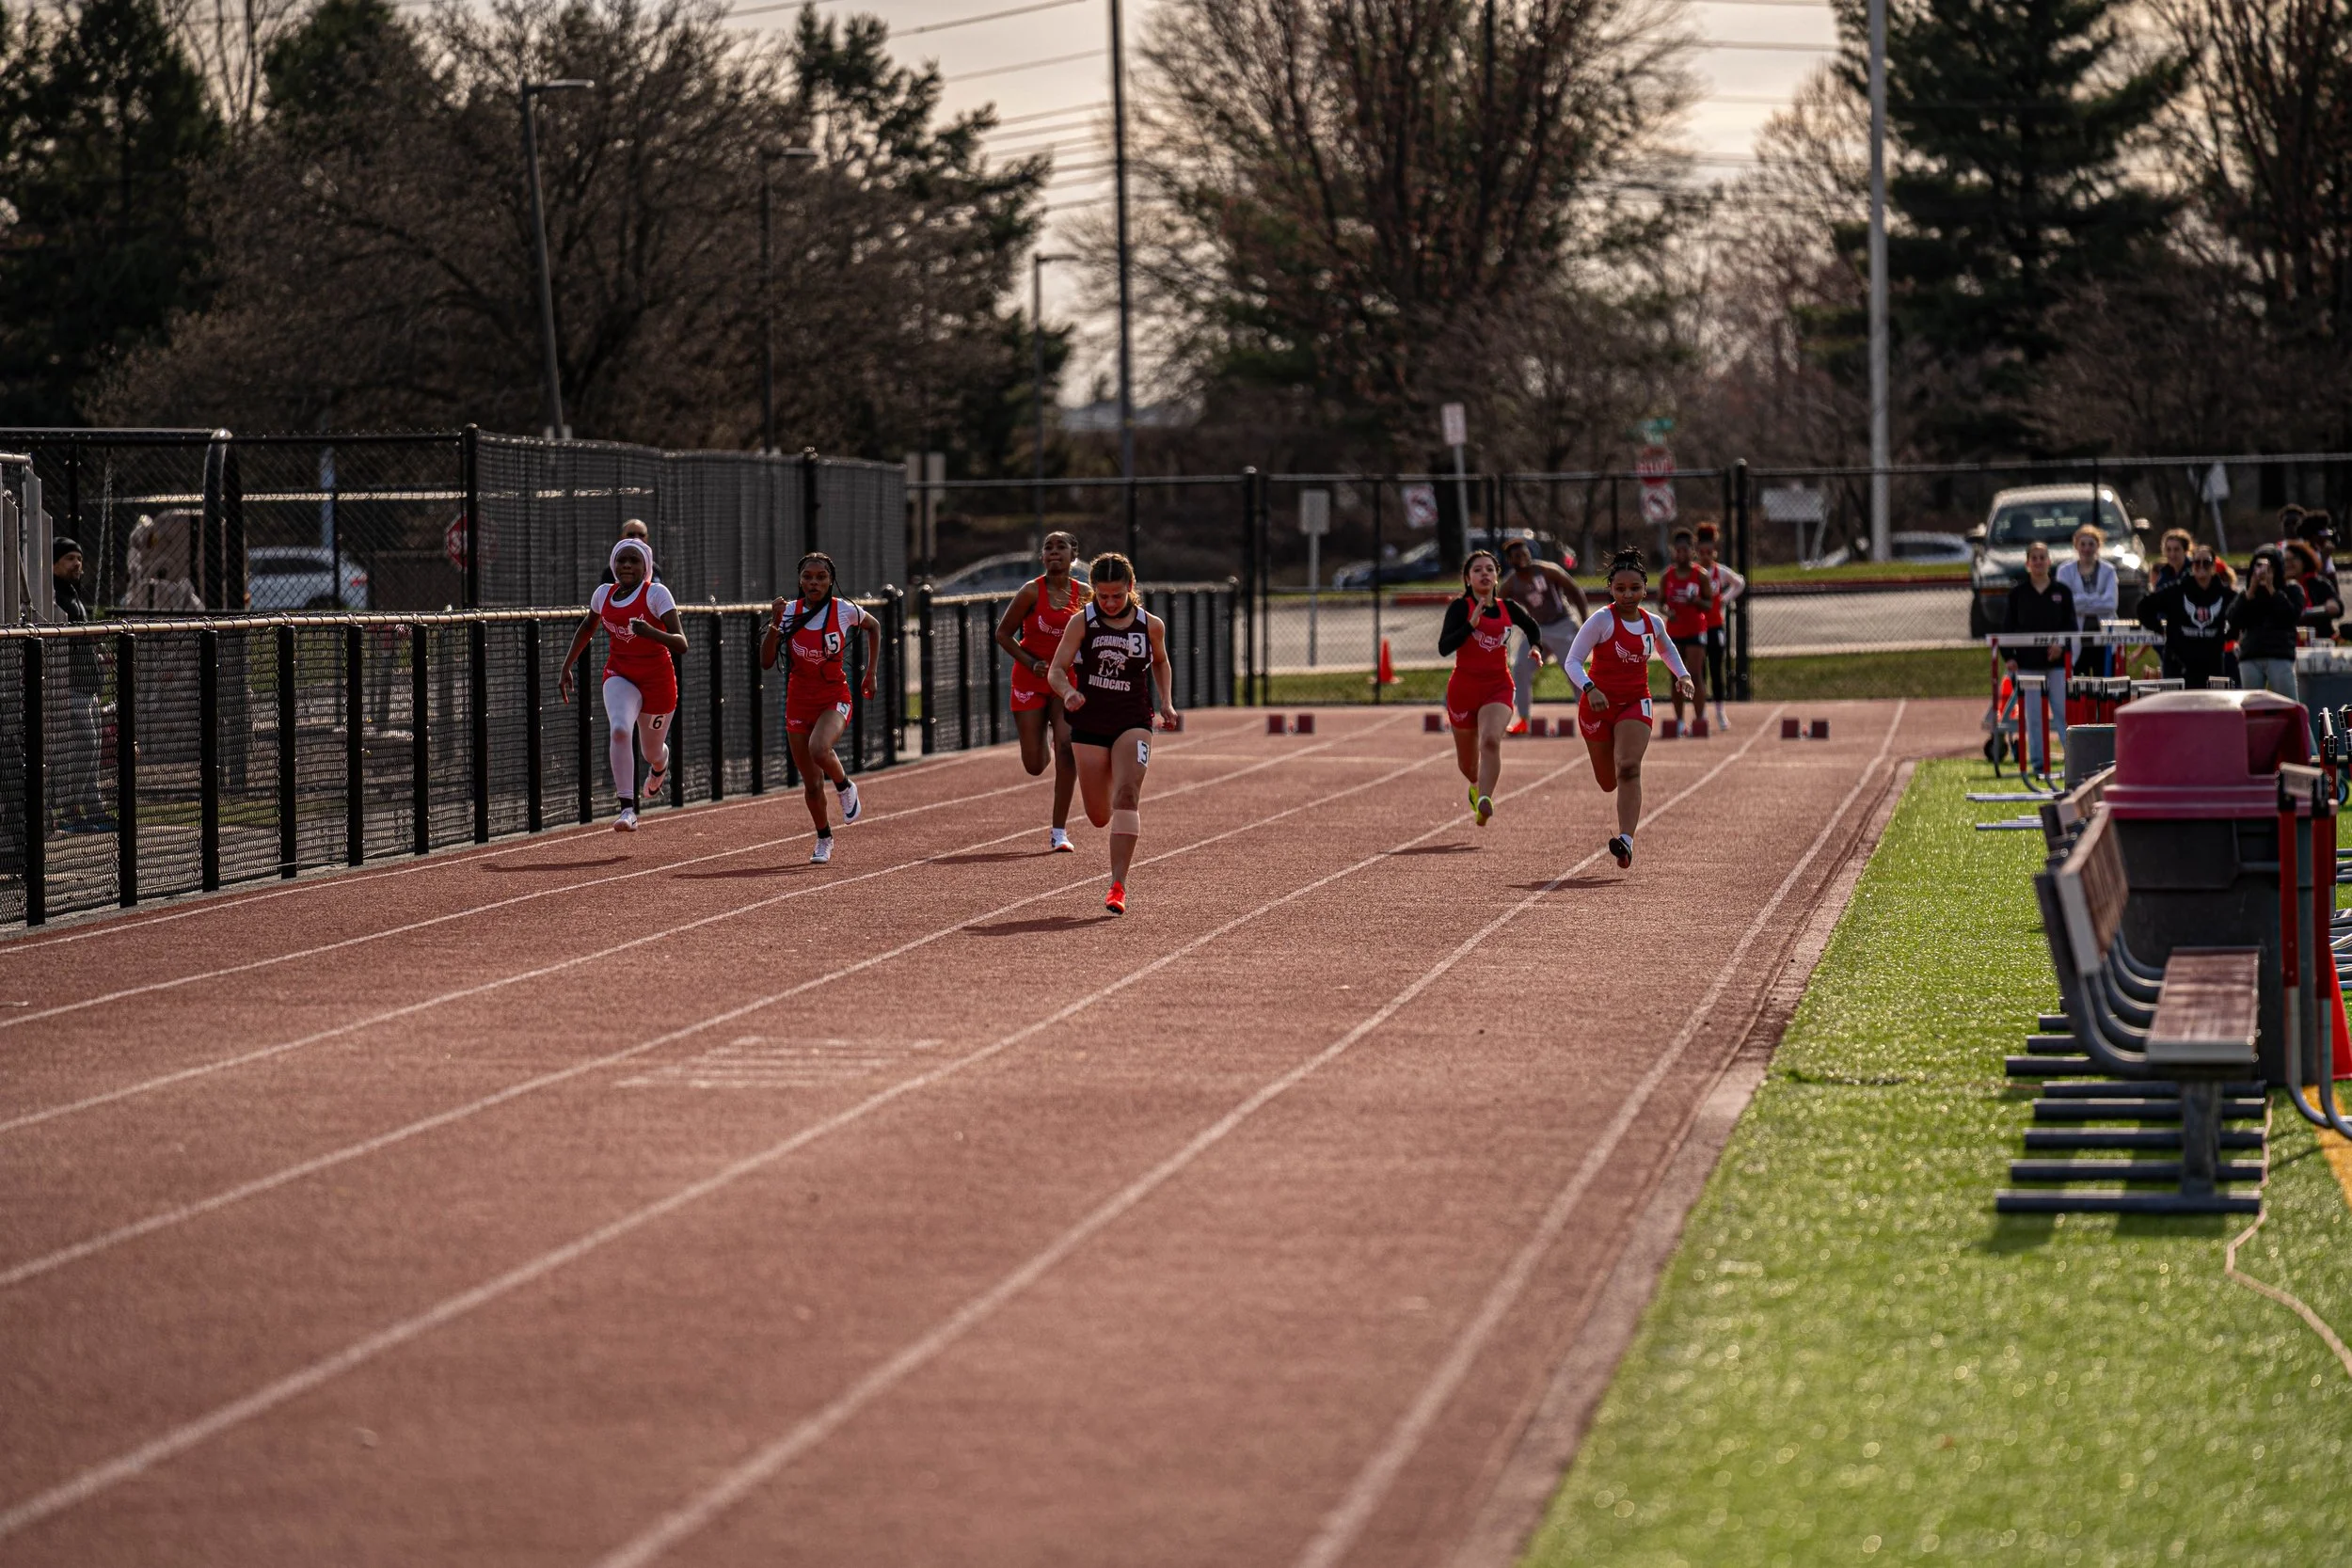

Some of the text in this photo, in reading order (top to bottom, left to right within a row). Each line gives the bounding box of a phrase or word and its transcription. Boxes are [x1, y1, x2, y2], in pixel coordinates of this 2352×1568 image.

[829, 633, 838, 654] 5
[1132, 634, 1142, 656] 3
[1645, 635, 1652, 654] 1
[1088, 673, 1131, 691] WILDCATS
[839, 703, 850, 716] 5
[1645, 699, 1651, 717] 1
[652, 715, 664, 729] 6
[1140, 742, 1149, 764] 3
